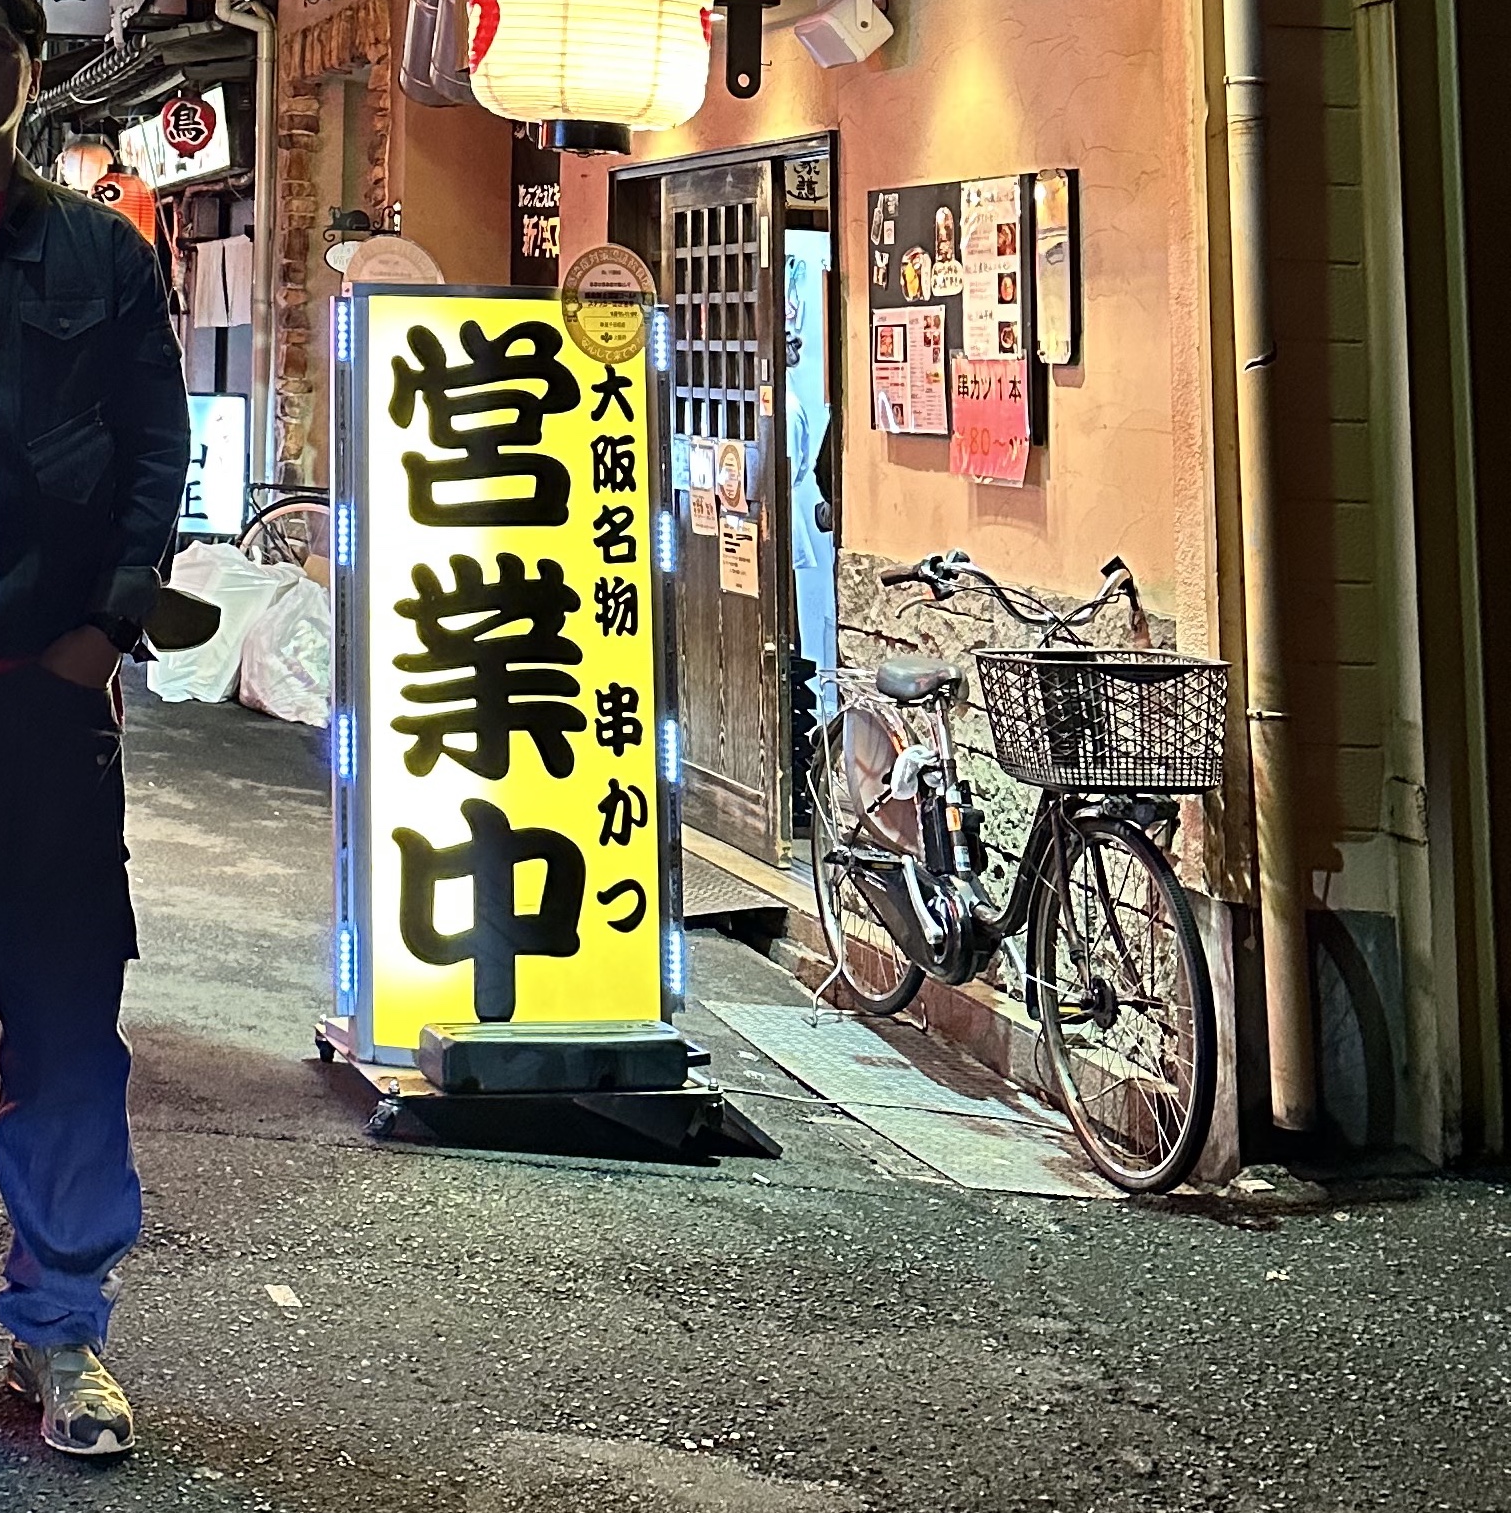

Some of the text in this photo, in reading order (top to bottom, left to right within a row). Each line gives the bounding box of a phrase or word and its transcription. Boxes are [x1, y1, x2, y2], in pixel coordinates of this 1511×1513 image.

[167, 102, 207, 144] 鳥
[590, 363, 639, 639] 大阪名物
[388, 317, 588, 1023] 営業中
[593, 681, 650, 935] 串かつ
